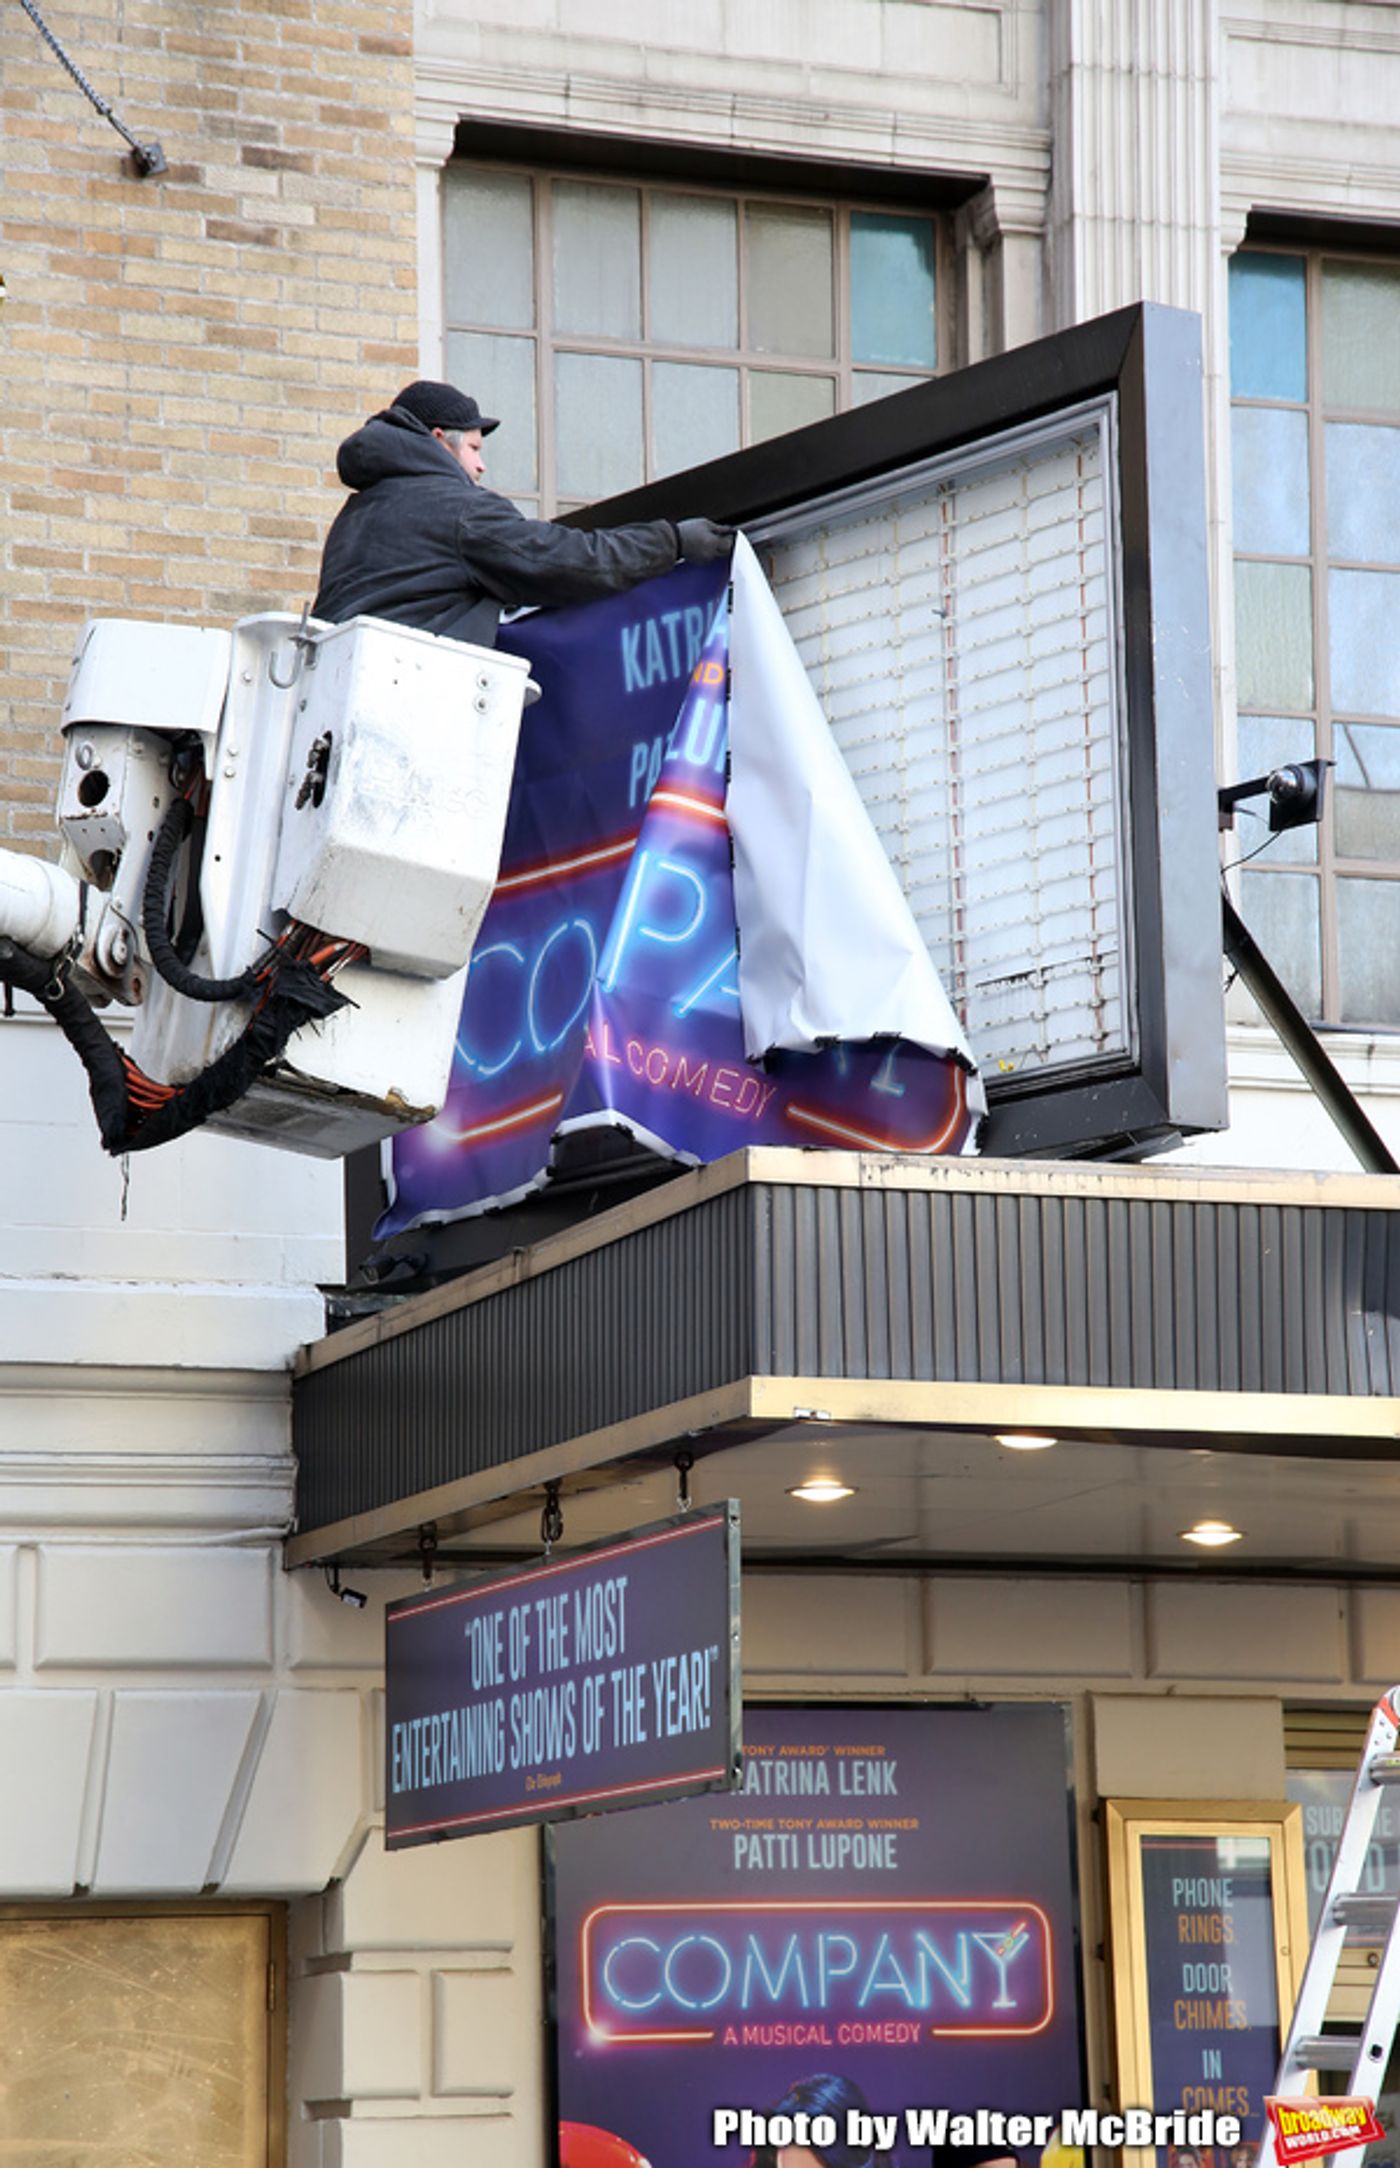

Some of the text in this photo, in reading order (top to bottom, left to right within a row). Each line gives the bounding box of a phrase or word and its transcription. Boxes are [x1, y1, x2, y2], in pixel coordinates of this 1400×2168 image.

[626, 1040, 777, 1118] COMEDY
[508, 1604, 531, 1682] OF
[535, 1593, 569, 1675] THE
[575, 1576, 628, 1665] MOST
[392, 1699, 505, 1794] ENTERTAINING
[509, 1681, 576, 1770] SHOWS
[582, 1674, 605, 1754] OF
[610, 1664, 647, 1748] THE
[742, 1745, 776, 1756] TONY
[834, 1745, 886, 1756] WINNER
[731, 1760, 898, 1796] ATRINA LENK
[710, 1819, 919, 1830] TWO-TIME TONY AWARD WINNER
[734, 1833, 898, 1870] PATTI LUPONE
[1172, 1878, 1233, 1908] PHONE
[603, 1925, 1029, 2009] COMPANY
[1183, 1962, 1233, 1994] DOOR
[723, 2022, 921, 2046] A MUSICAL COMEDY
[1202, 2048, 1222, 2080] IN
